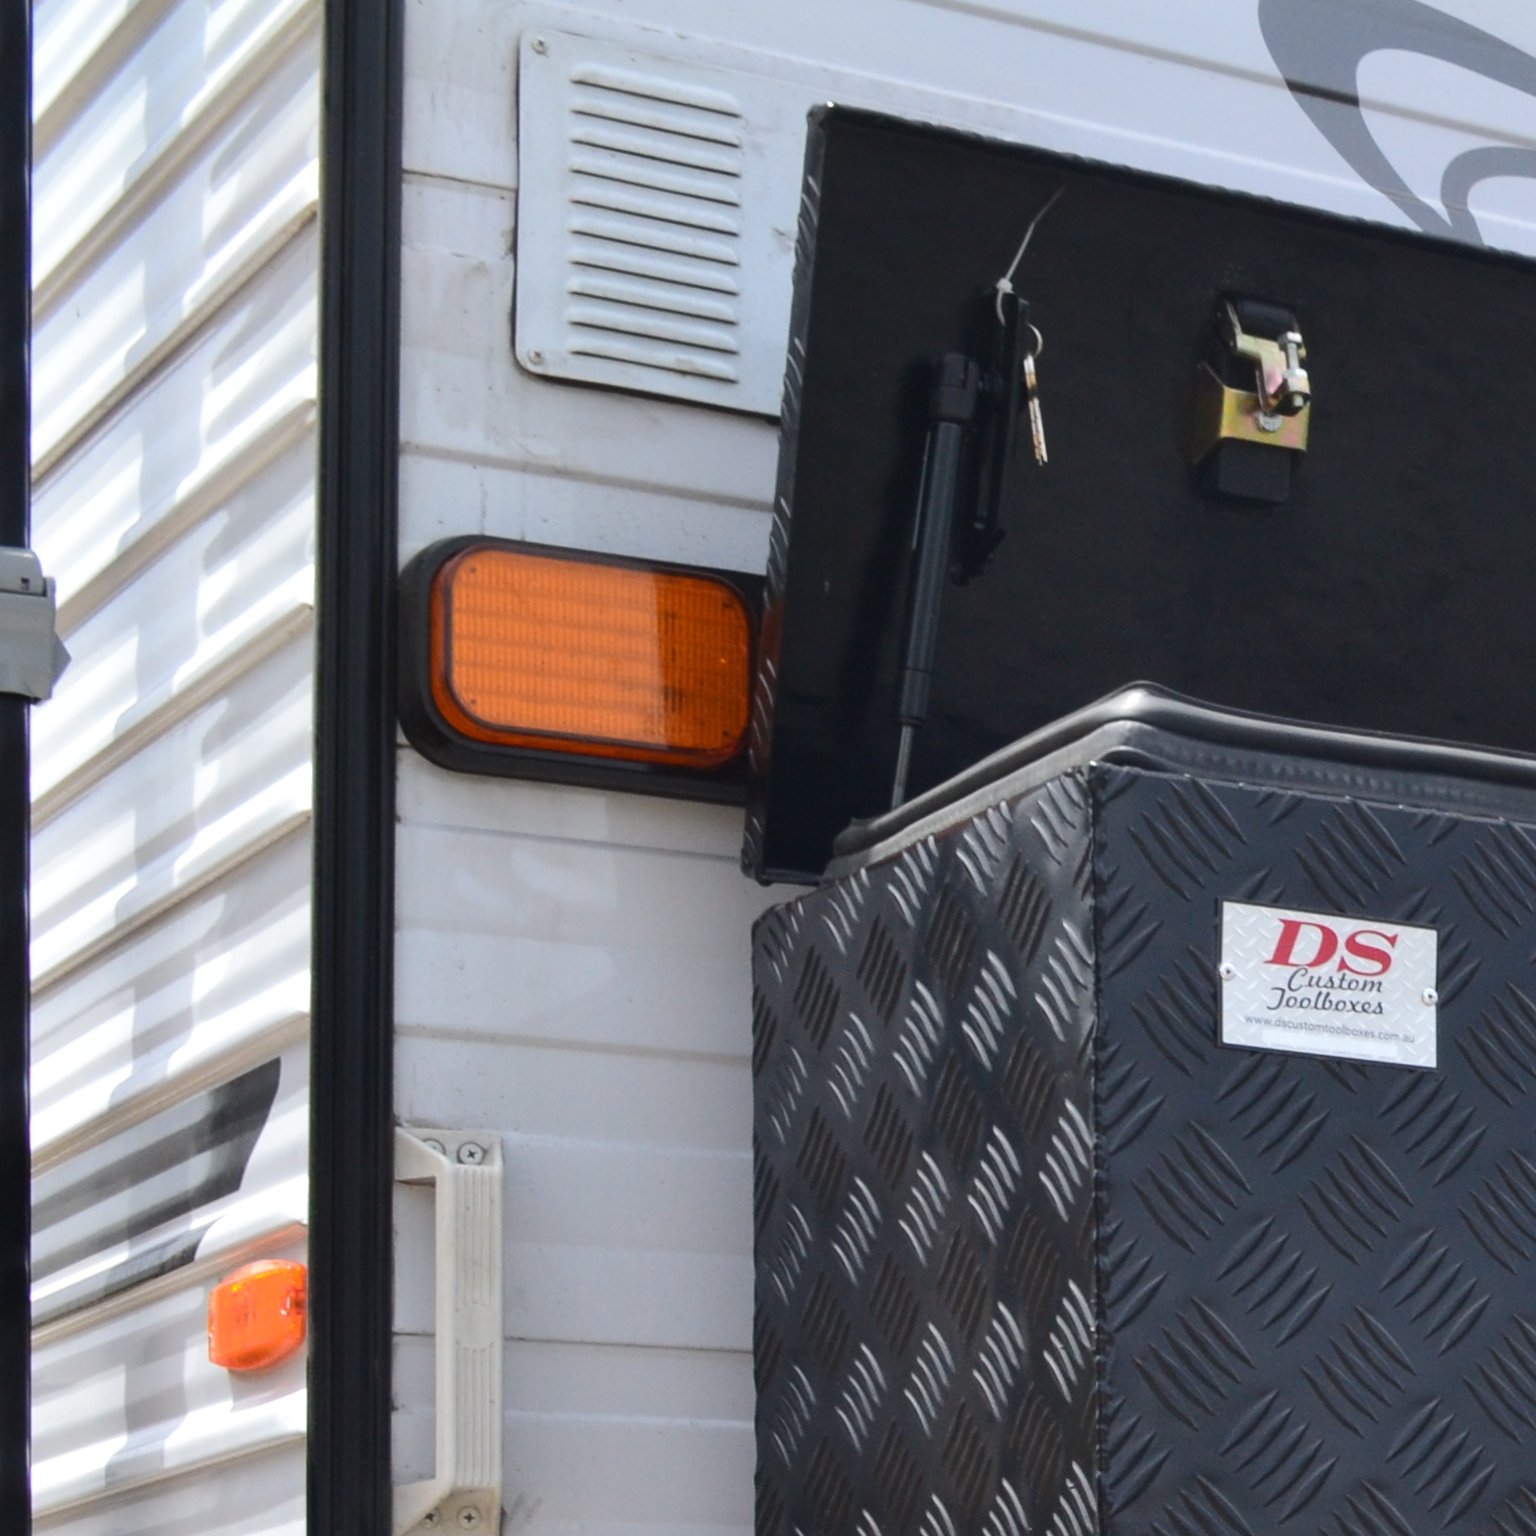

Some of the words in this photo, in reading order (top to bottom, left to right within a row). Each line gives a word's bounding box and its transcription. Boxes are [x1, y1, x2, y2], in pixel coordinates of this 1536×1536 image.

[1263, 917, 1399, 977] DS
[1287, 967, 1383, 993] Custom
[1266, 987, 1384, 1015] Toolboxes
[1244, 1014, 1415, 1044] www.dscustomtoolboxes.com.au
